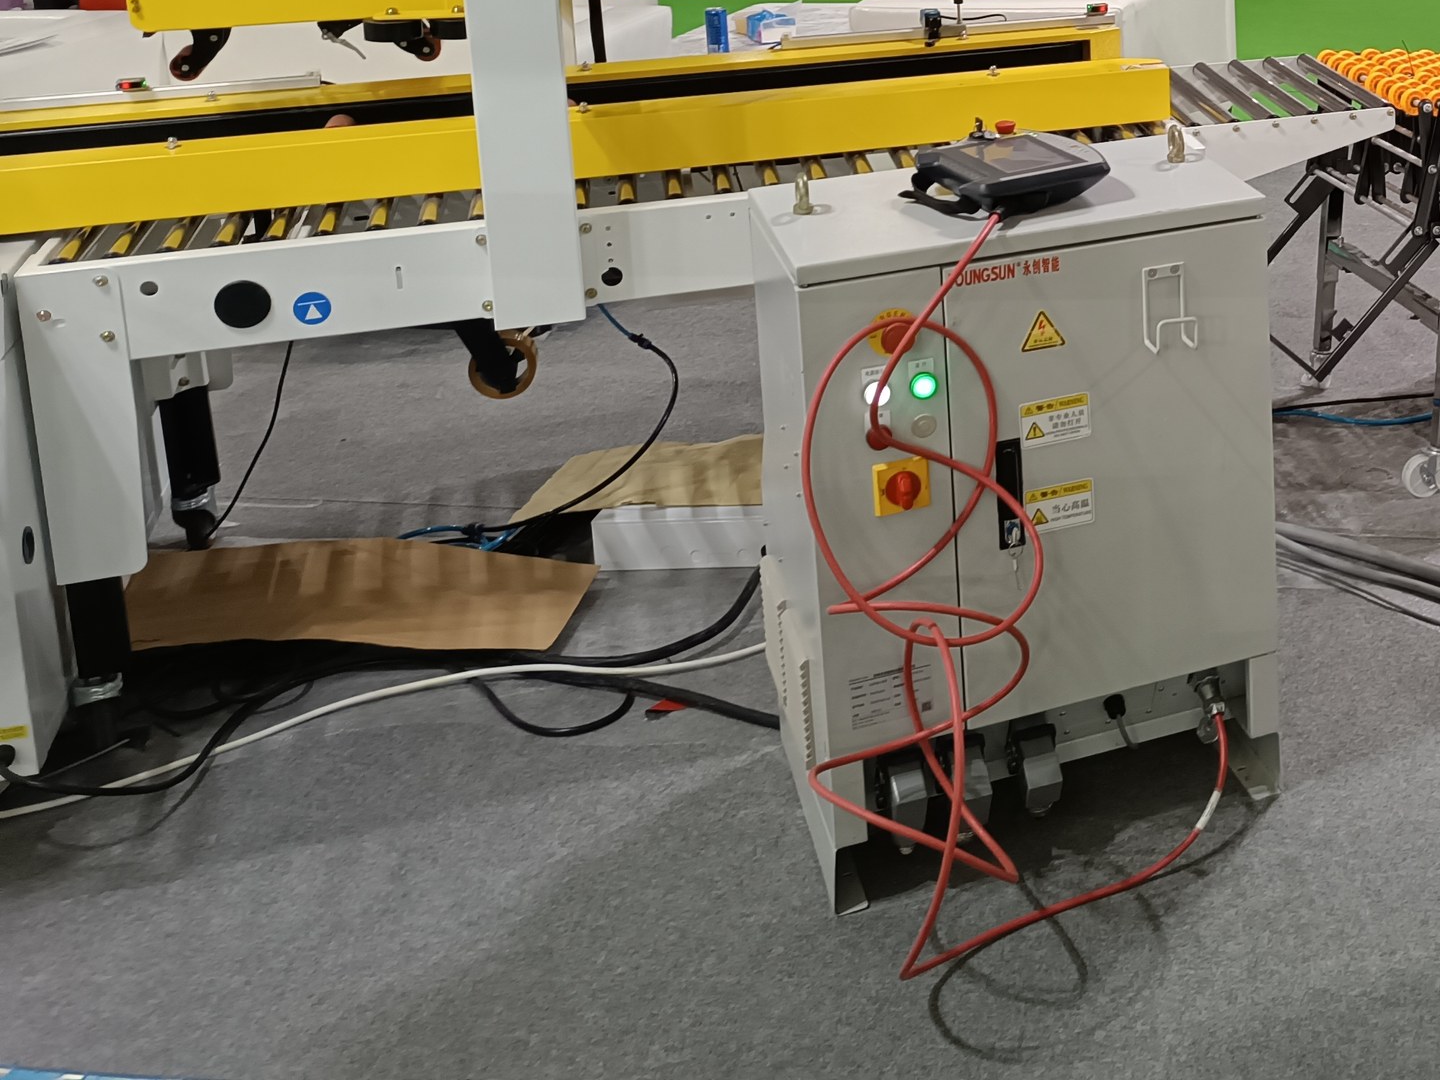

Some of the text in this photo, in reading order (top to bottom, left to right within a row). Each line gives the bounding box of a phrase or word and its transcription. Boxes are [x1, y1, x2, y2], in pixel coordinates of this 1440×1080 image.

[949, 263, 1016, 287] OUNGSUN
[1022, 256, 1060, 276] 永创智能
